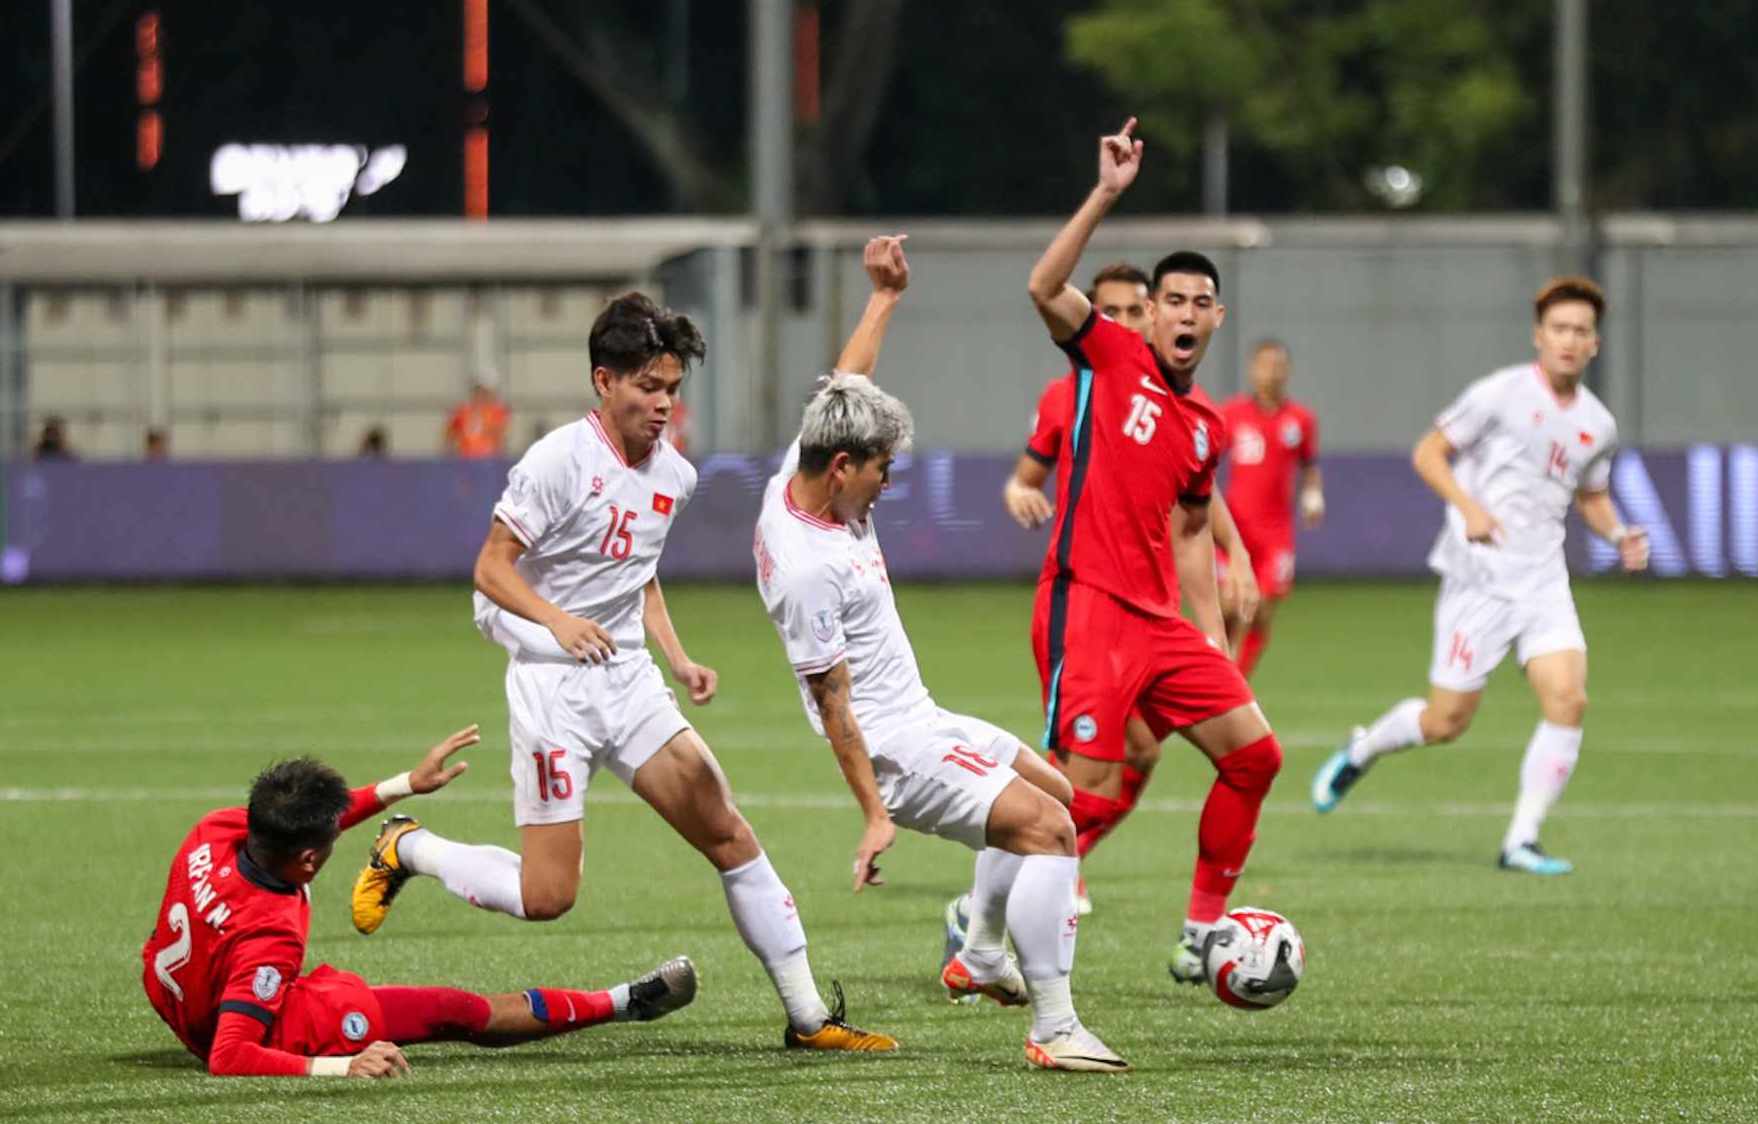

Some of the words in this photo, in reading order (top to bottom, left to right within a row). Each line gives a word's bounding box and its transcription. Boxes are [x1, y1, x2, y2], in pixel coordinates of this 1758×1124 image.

[1123, 393, 1163, 446] 15
[1547, 439, 1569, 478] 14
[600, 504, 637, 561] 15
[1448, 629, 1474, 673] 14
[533, 749, 573, 802] 15
[188, 842, 217, 912] IRFAN
[154, 902, 192, 1003] 2
